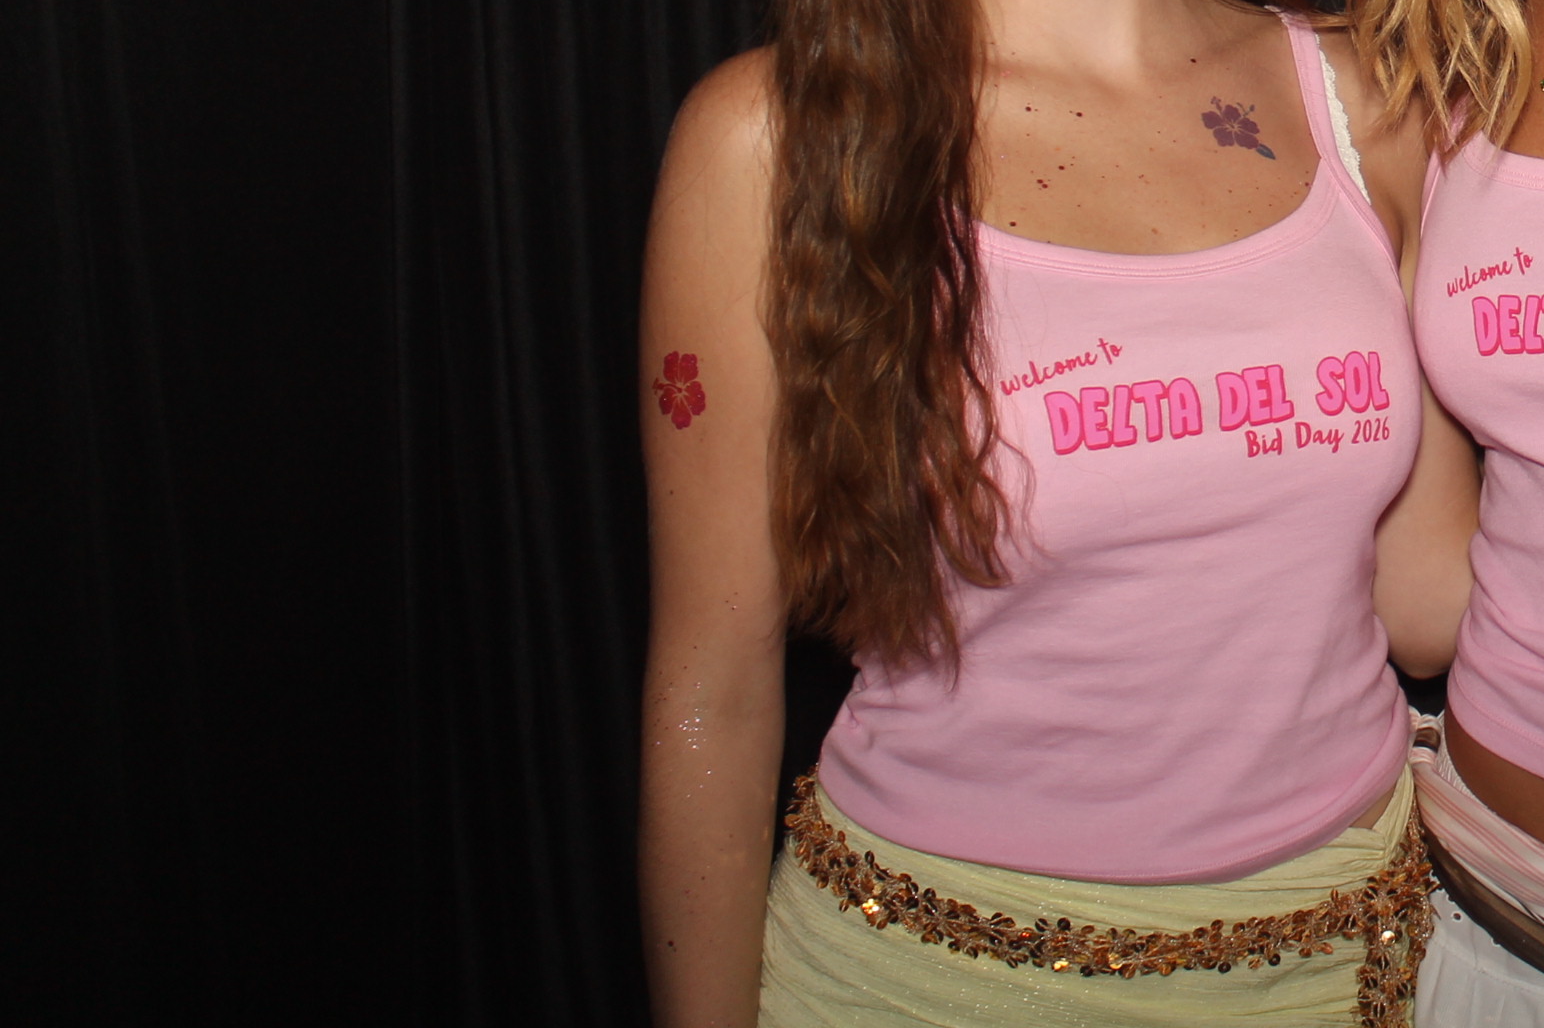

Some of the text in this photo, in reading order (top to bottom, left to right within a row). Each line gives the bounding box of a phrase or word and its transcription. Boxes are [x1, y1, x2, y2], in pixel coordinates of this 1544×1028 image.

[1447, 246, 1533, 297] welcome to
[1000, 338, 1122, 396] welcome to
[1044, 351, 1390, 455] DELTA DEL SOL
[1245, 417, 1390, 458] Bid Day 2026
